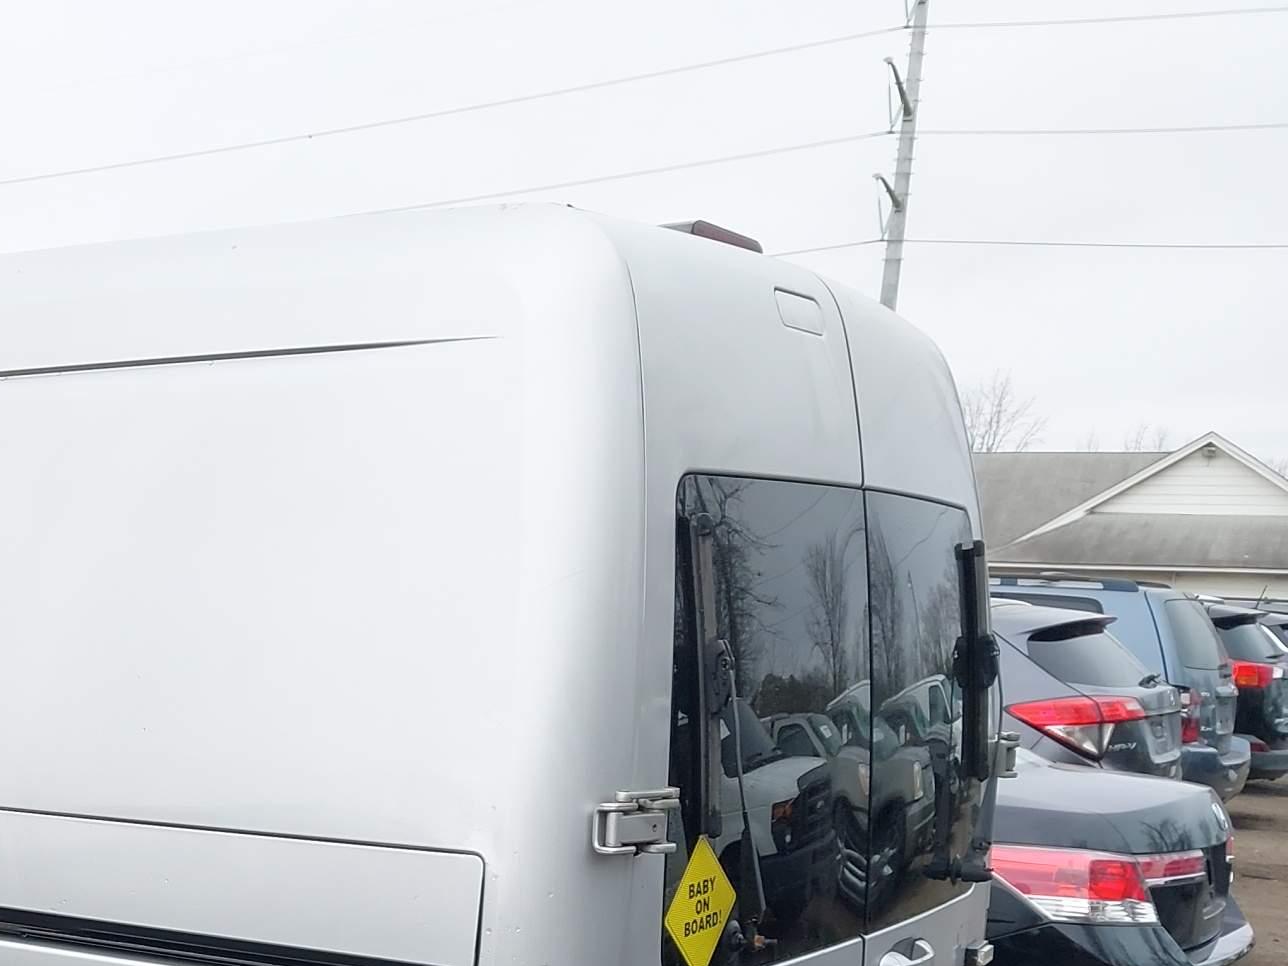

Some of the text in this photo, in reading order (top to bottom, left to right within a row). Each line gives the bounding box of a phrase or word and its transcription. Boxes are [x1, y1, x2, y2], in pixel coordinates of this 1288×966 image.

[688, 876, 717, 899] BABY
[695, 896, 710, 914] ON
[684, 910, 722, 938] BOARD!
